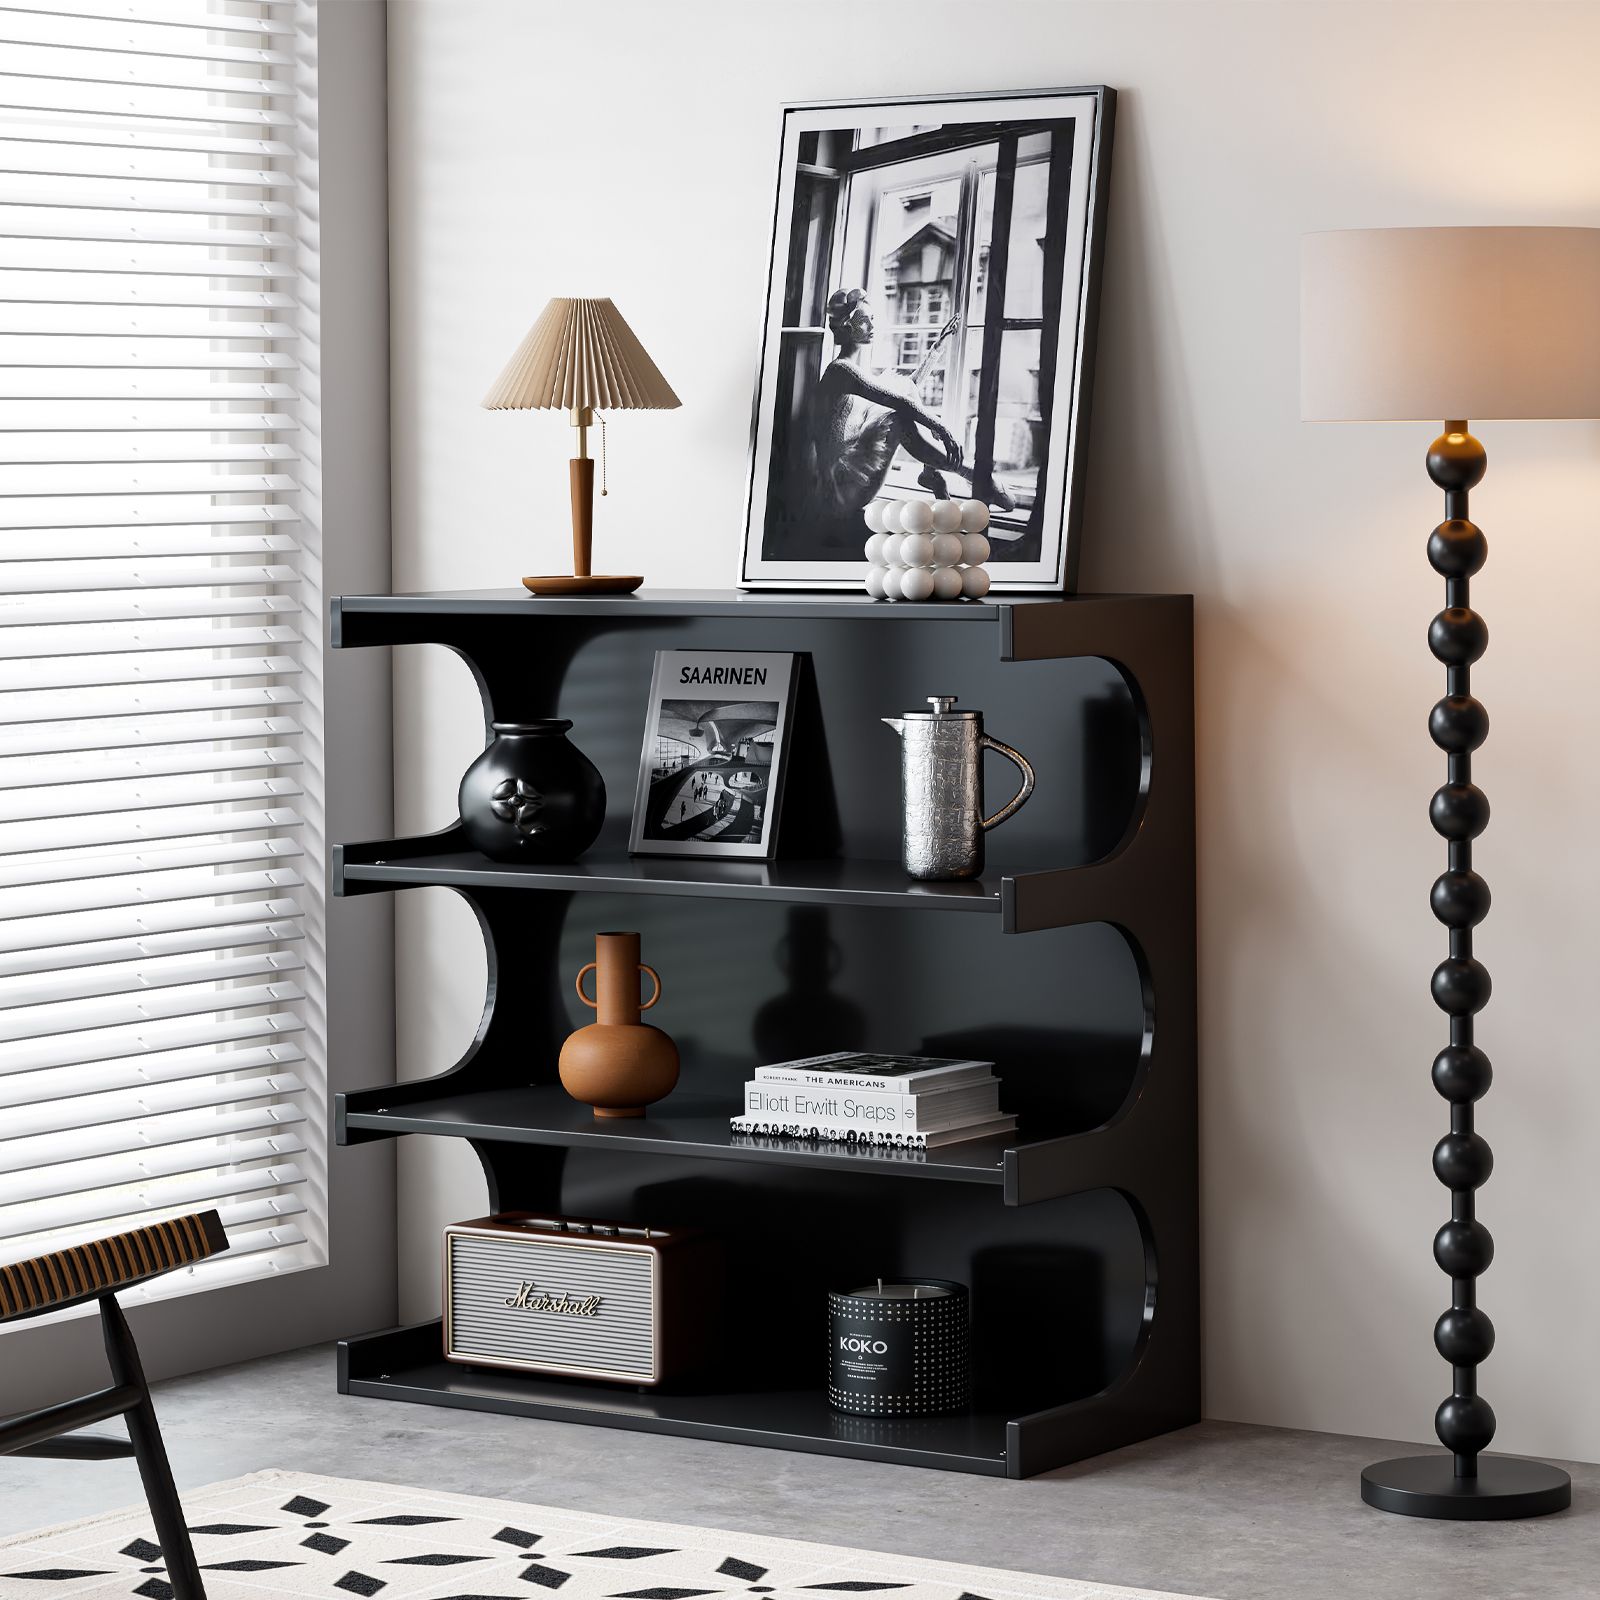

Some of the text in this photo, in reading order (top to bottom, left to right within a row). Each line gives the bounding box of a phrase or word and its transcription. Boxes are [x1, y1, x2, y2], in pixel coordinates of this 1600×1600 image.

[680, 666, 767, 685] SAARINEN
[805, 1076, 886, 1089] THE AMERICANS
[749, 1092, 790, 1112] Elliott
[795, 1095, 838, 1116] Erwitt
[843, 1099, 896, 1123] Snaps
[504, 1280, 601, 1316] Marshall
[840, 1336, 888, 1354] KOKO
